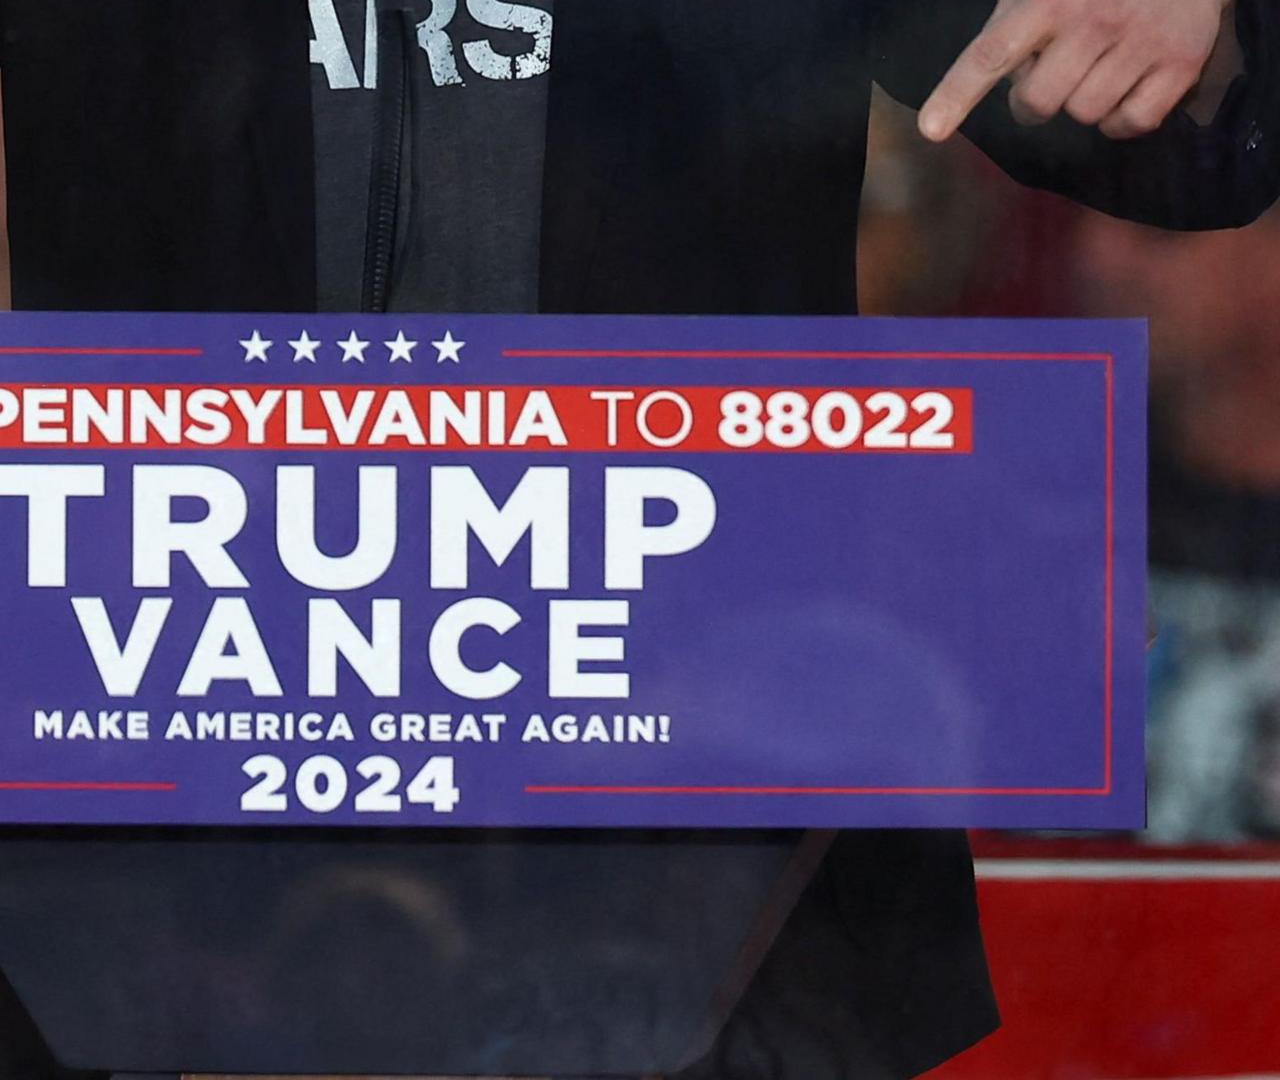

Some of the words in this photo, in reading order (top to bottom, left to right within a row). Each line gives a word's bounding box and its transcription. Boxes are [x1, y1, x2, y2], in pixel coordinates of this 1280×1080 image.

[590, 391, 693, 447] TO
[718, 391, 954, 448] 88022
[71, 597, 631, 699] VANCE
[34, 710, 149, 740] MAKE
[165, 711, 354, 741] AMERICA
[370, 713, 507, 742] GREAT
[521, 714, 670, 743] AGAIN!
[240, 754, 460, 812] 2024
